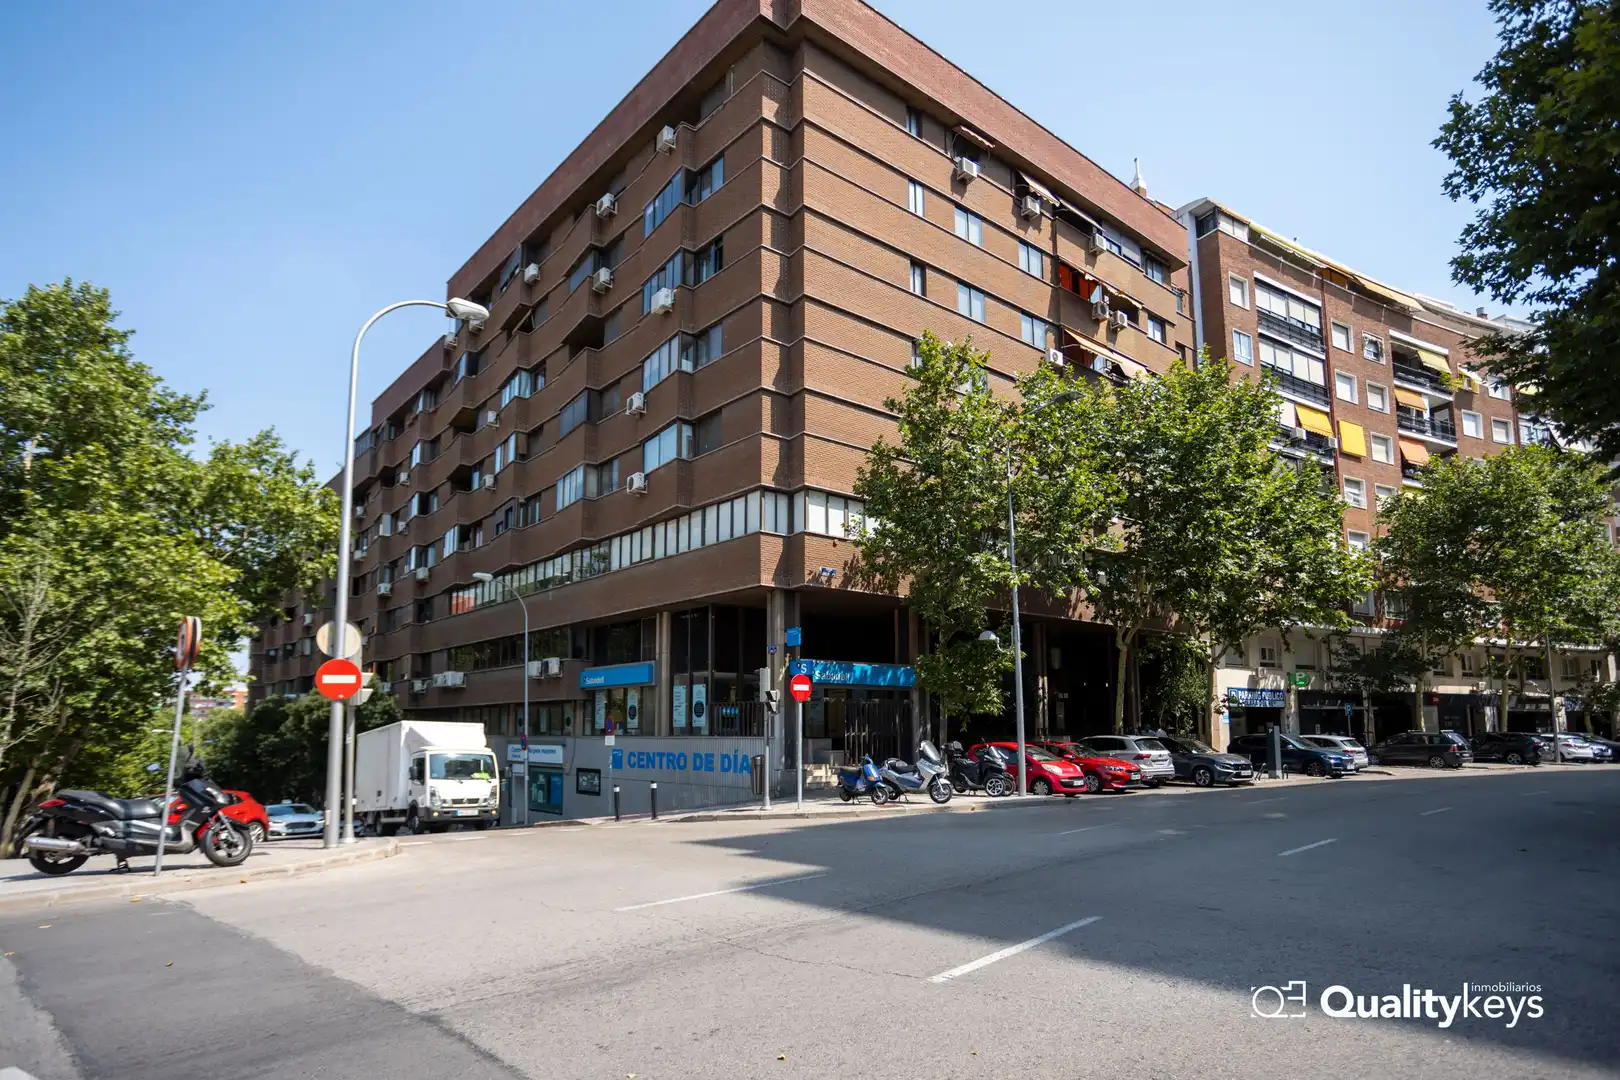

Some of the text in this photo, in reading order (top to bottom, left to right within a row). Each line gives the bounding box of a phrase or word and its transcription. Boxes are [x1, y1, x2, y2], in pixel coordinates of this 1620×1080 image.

[1295, 672, 1306, 682] P
[1238, 690, 1261, 700] PARKING
[627, 748, 752, 775] CENTRO DE DÍA
